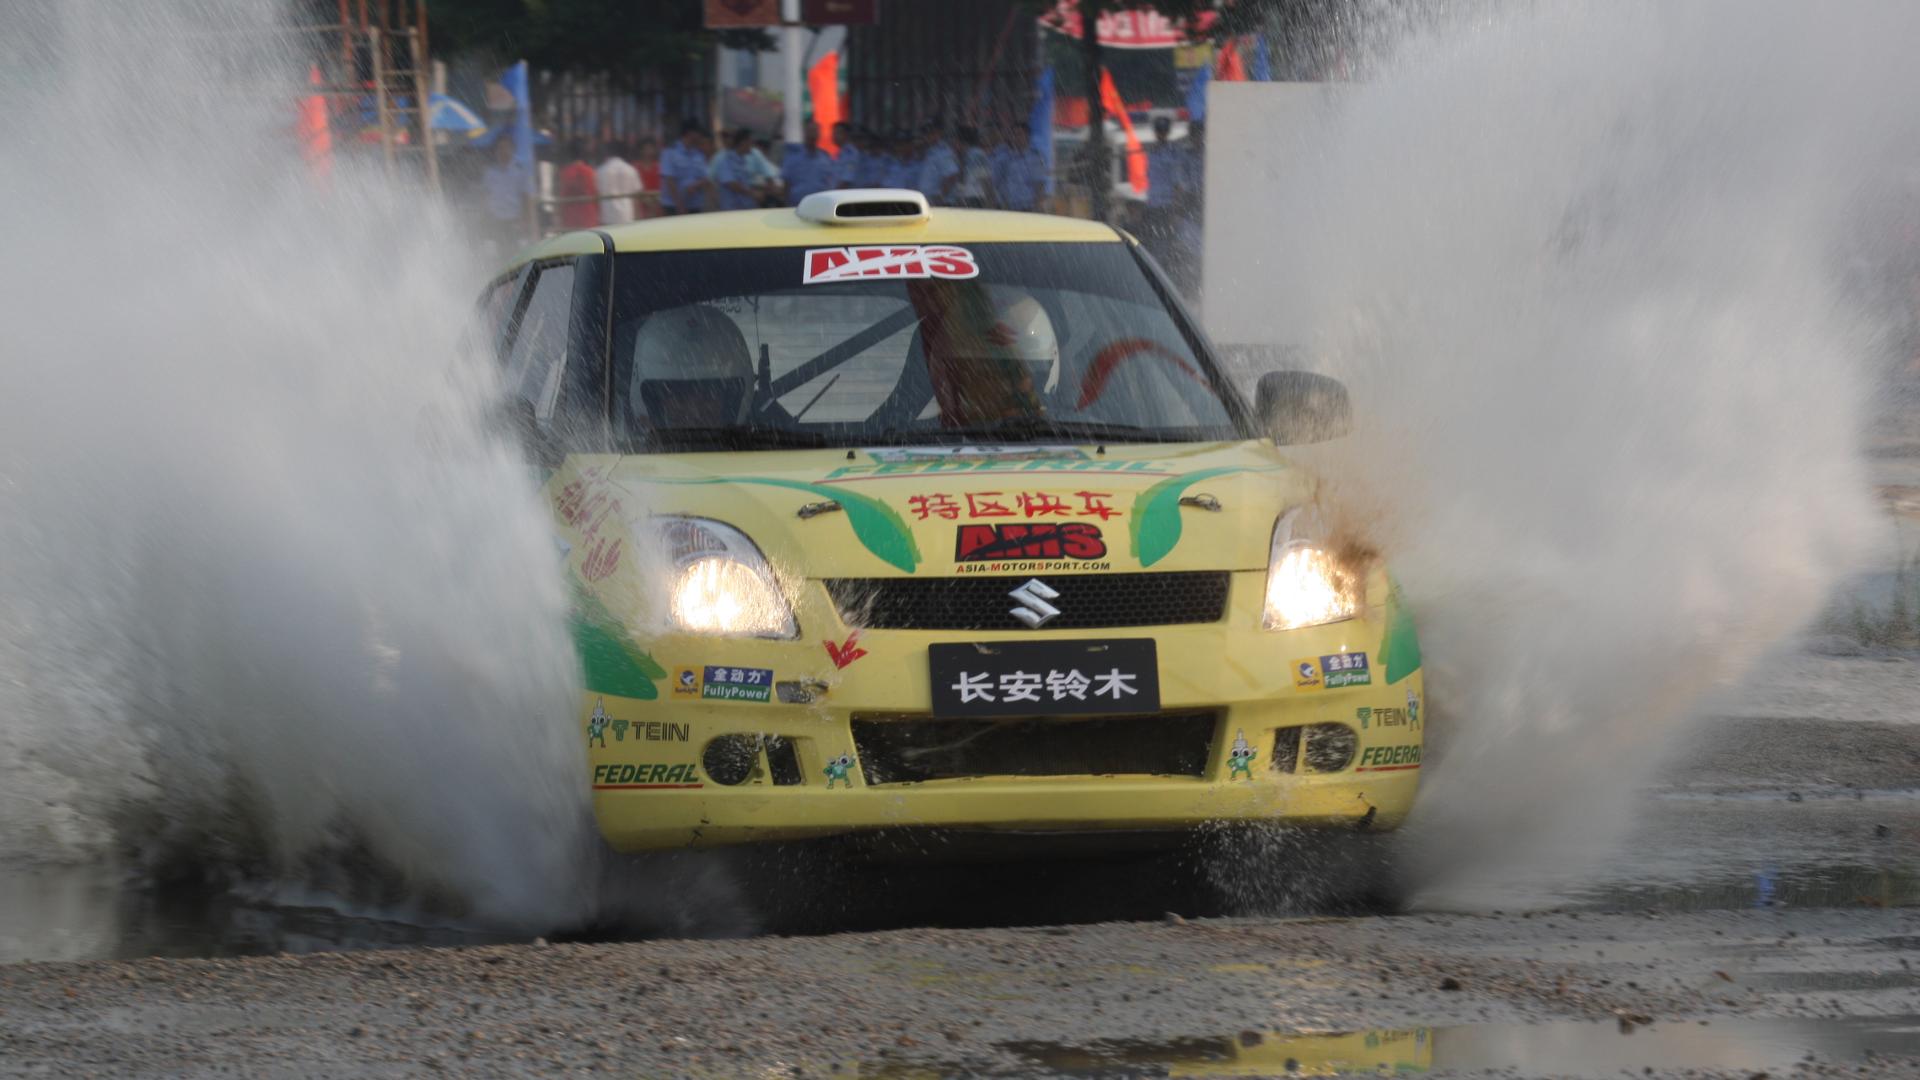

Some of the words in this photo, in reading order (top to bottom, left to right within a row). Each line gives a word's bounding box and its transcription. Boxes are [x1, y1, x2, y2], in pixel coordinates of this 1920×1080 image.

[803, 245, 980, 284] AMS
[824, 459, 1172, 479] FEDERAL
[908, 491, 1123, 520] 特区快车
[955, 522, 1107, 562] AMS
[956, 562, 1110, 574] ASIA-MOTORSPORT.COM
[703, 685, 769, 699] FullyPower
[951, 668, 1138, 703] 长安铃木
[1360, 744, 1422, 766] FEDERA
[594, 764, 700, 783] FEDERAL
